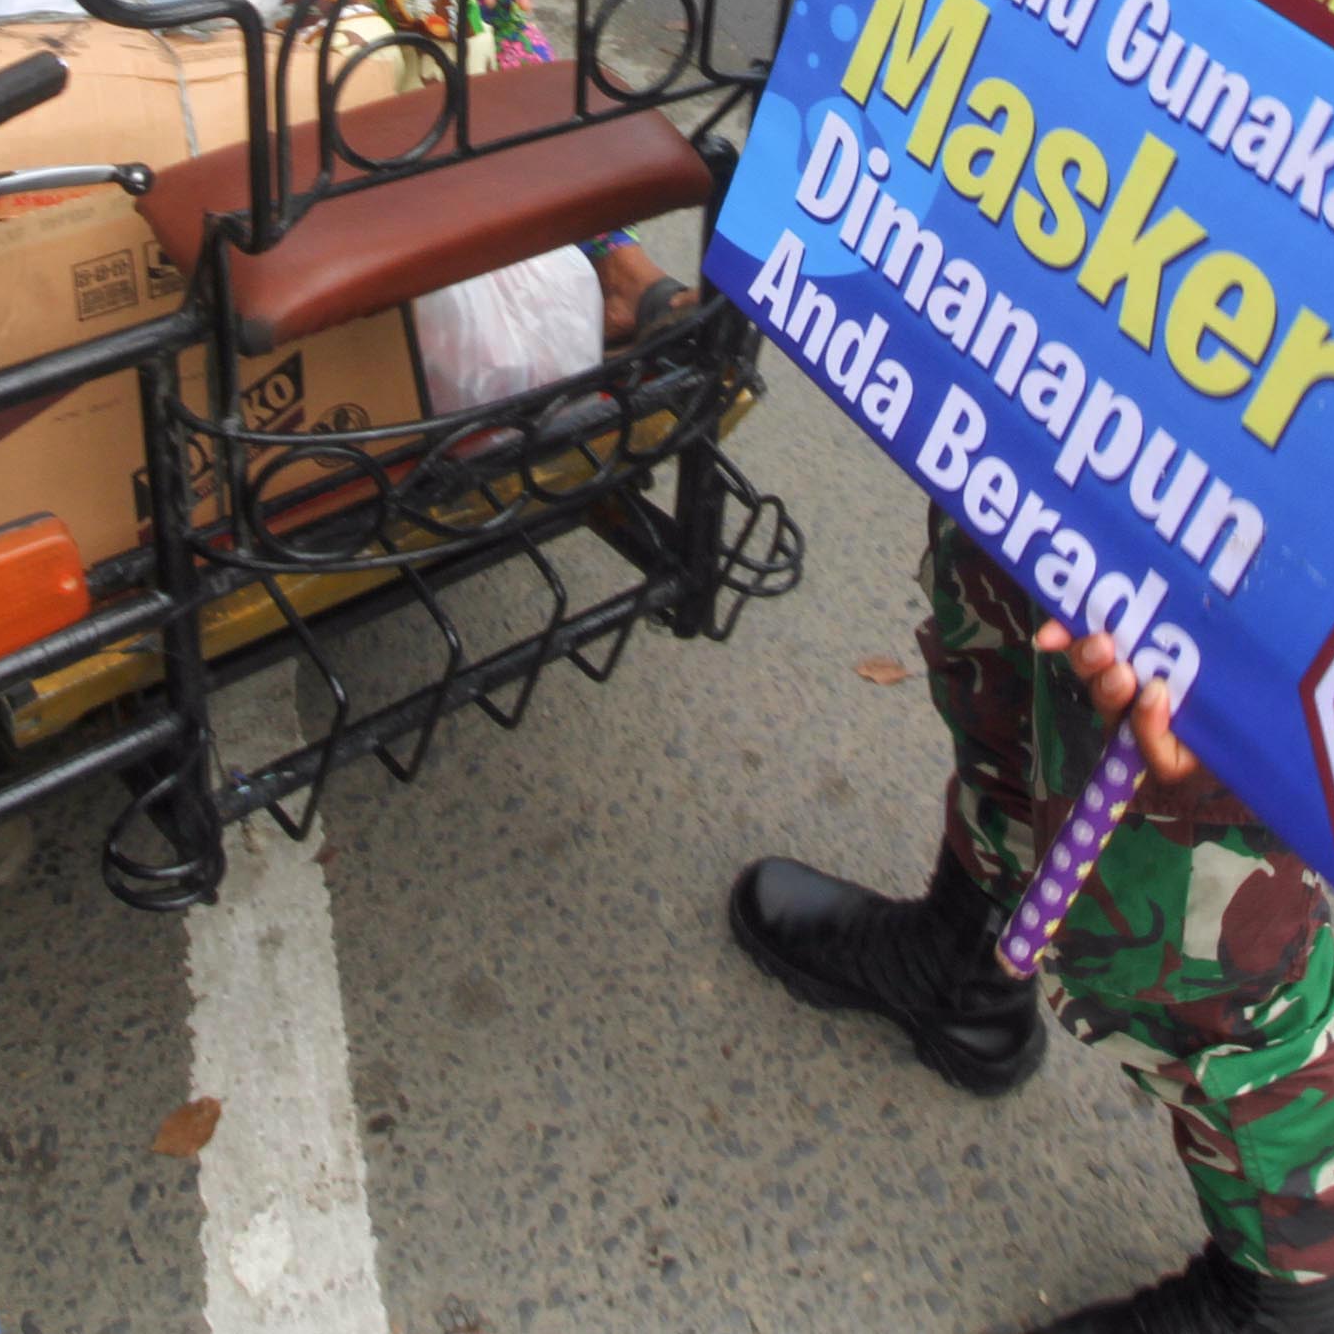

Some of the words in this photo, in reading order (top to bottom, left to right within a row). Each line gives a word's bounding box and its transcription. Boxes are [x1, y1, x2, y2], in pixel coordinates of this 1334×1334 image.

[747, 229, 915, 441] Anda
[915, 383, 1202, 716] Berada
[795, 111, 1265, 596] Dimanapun
